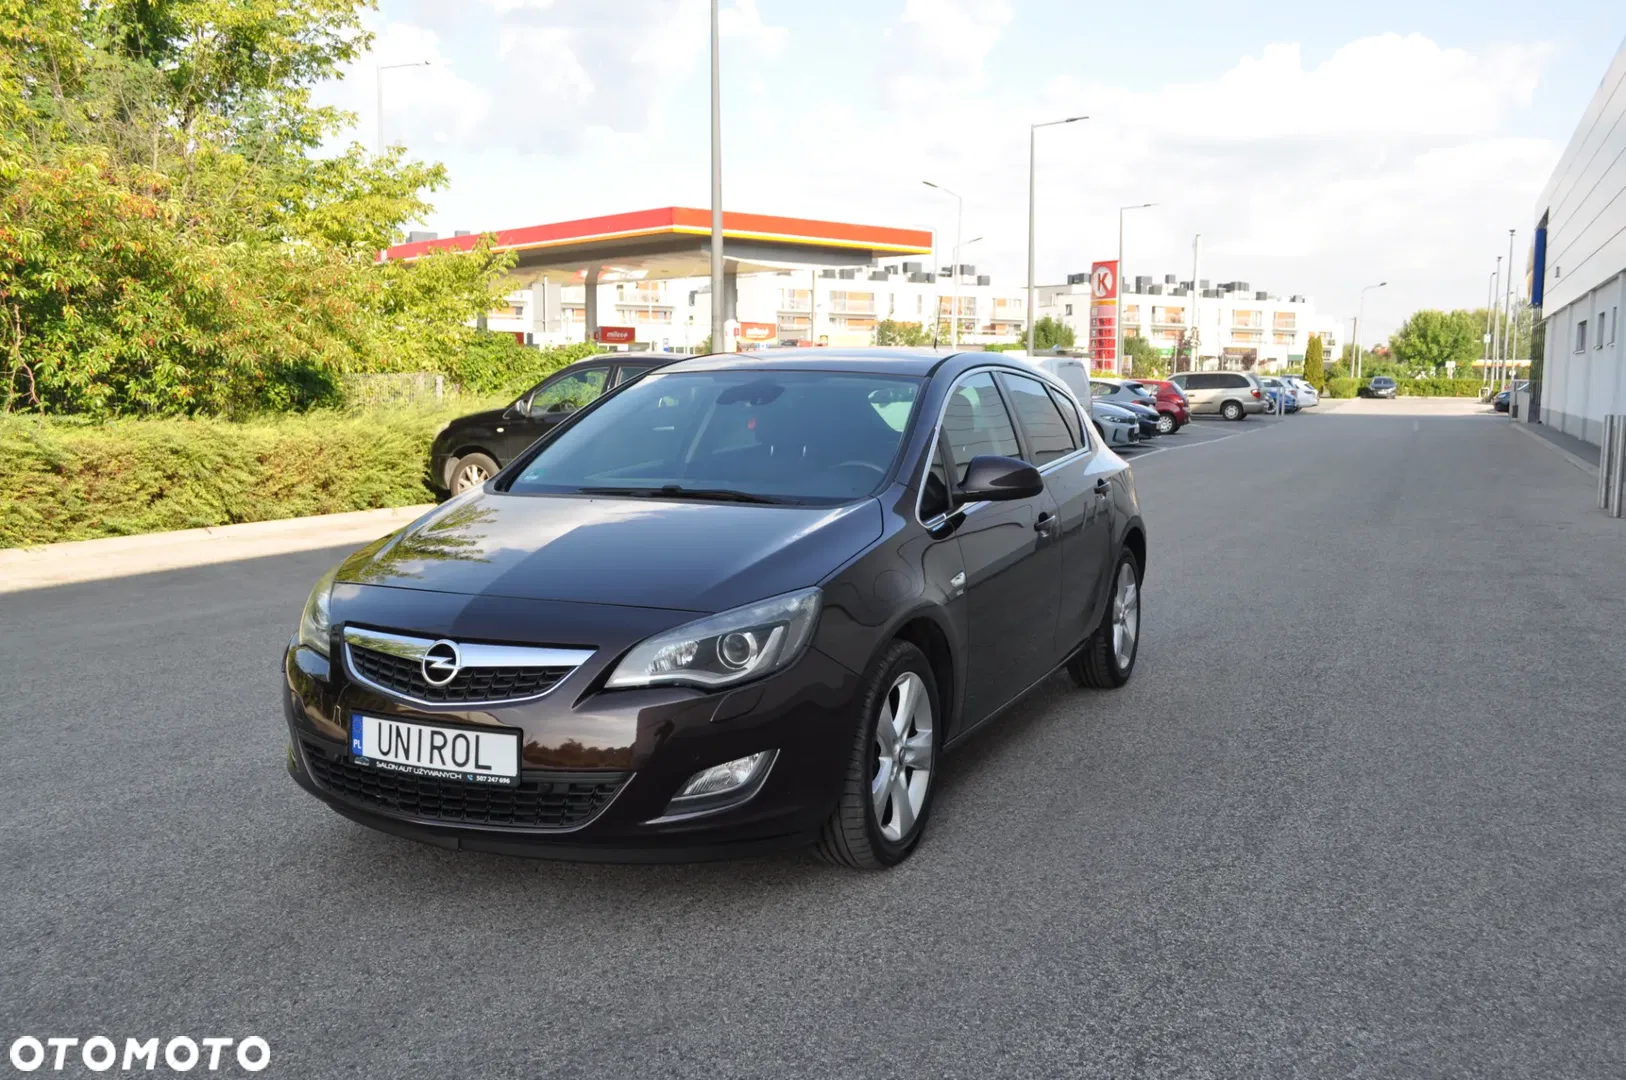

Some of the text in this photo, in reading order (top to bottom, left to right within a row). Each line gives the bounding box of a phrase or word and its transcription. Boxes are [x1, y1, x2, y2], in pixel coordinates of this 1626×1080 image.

[1097, 272, 1111, 293] K
[353, 739, 362, 749] PL
[378, 721, 492, 771] UNIROL
[376, 761, 398, 771] SALON
